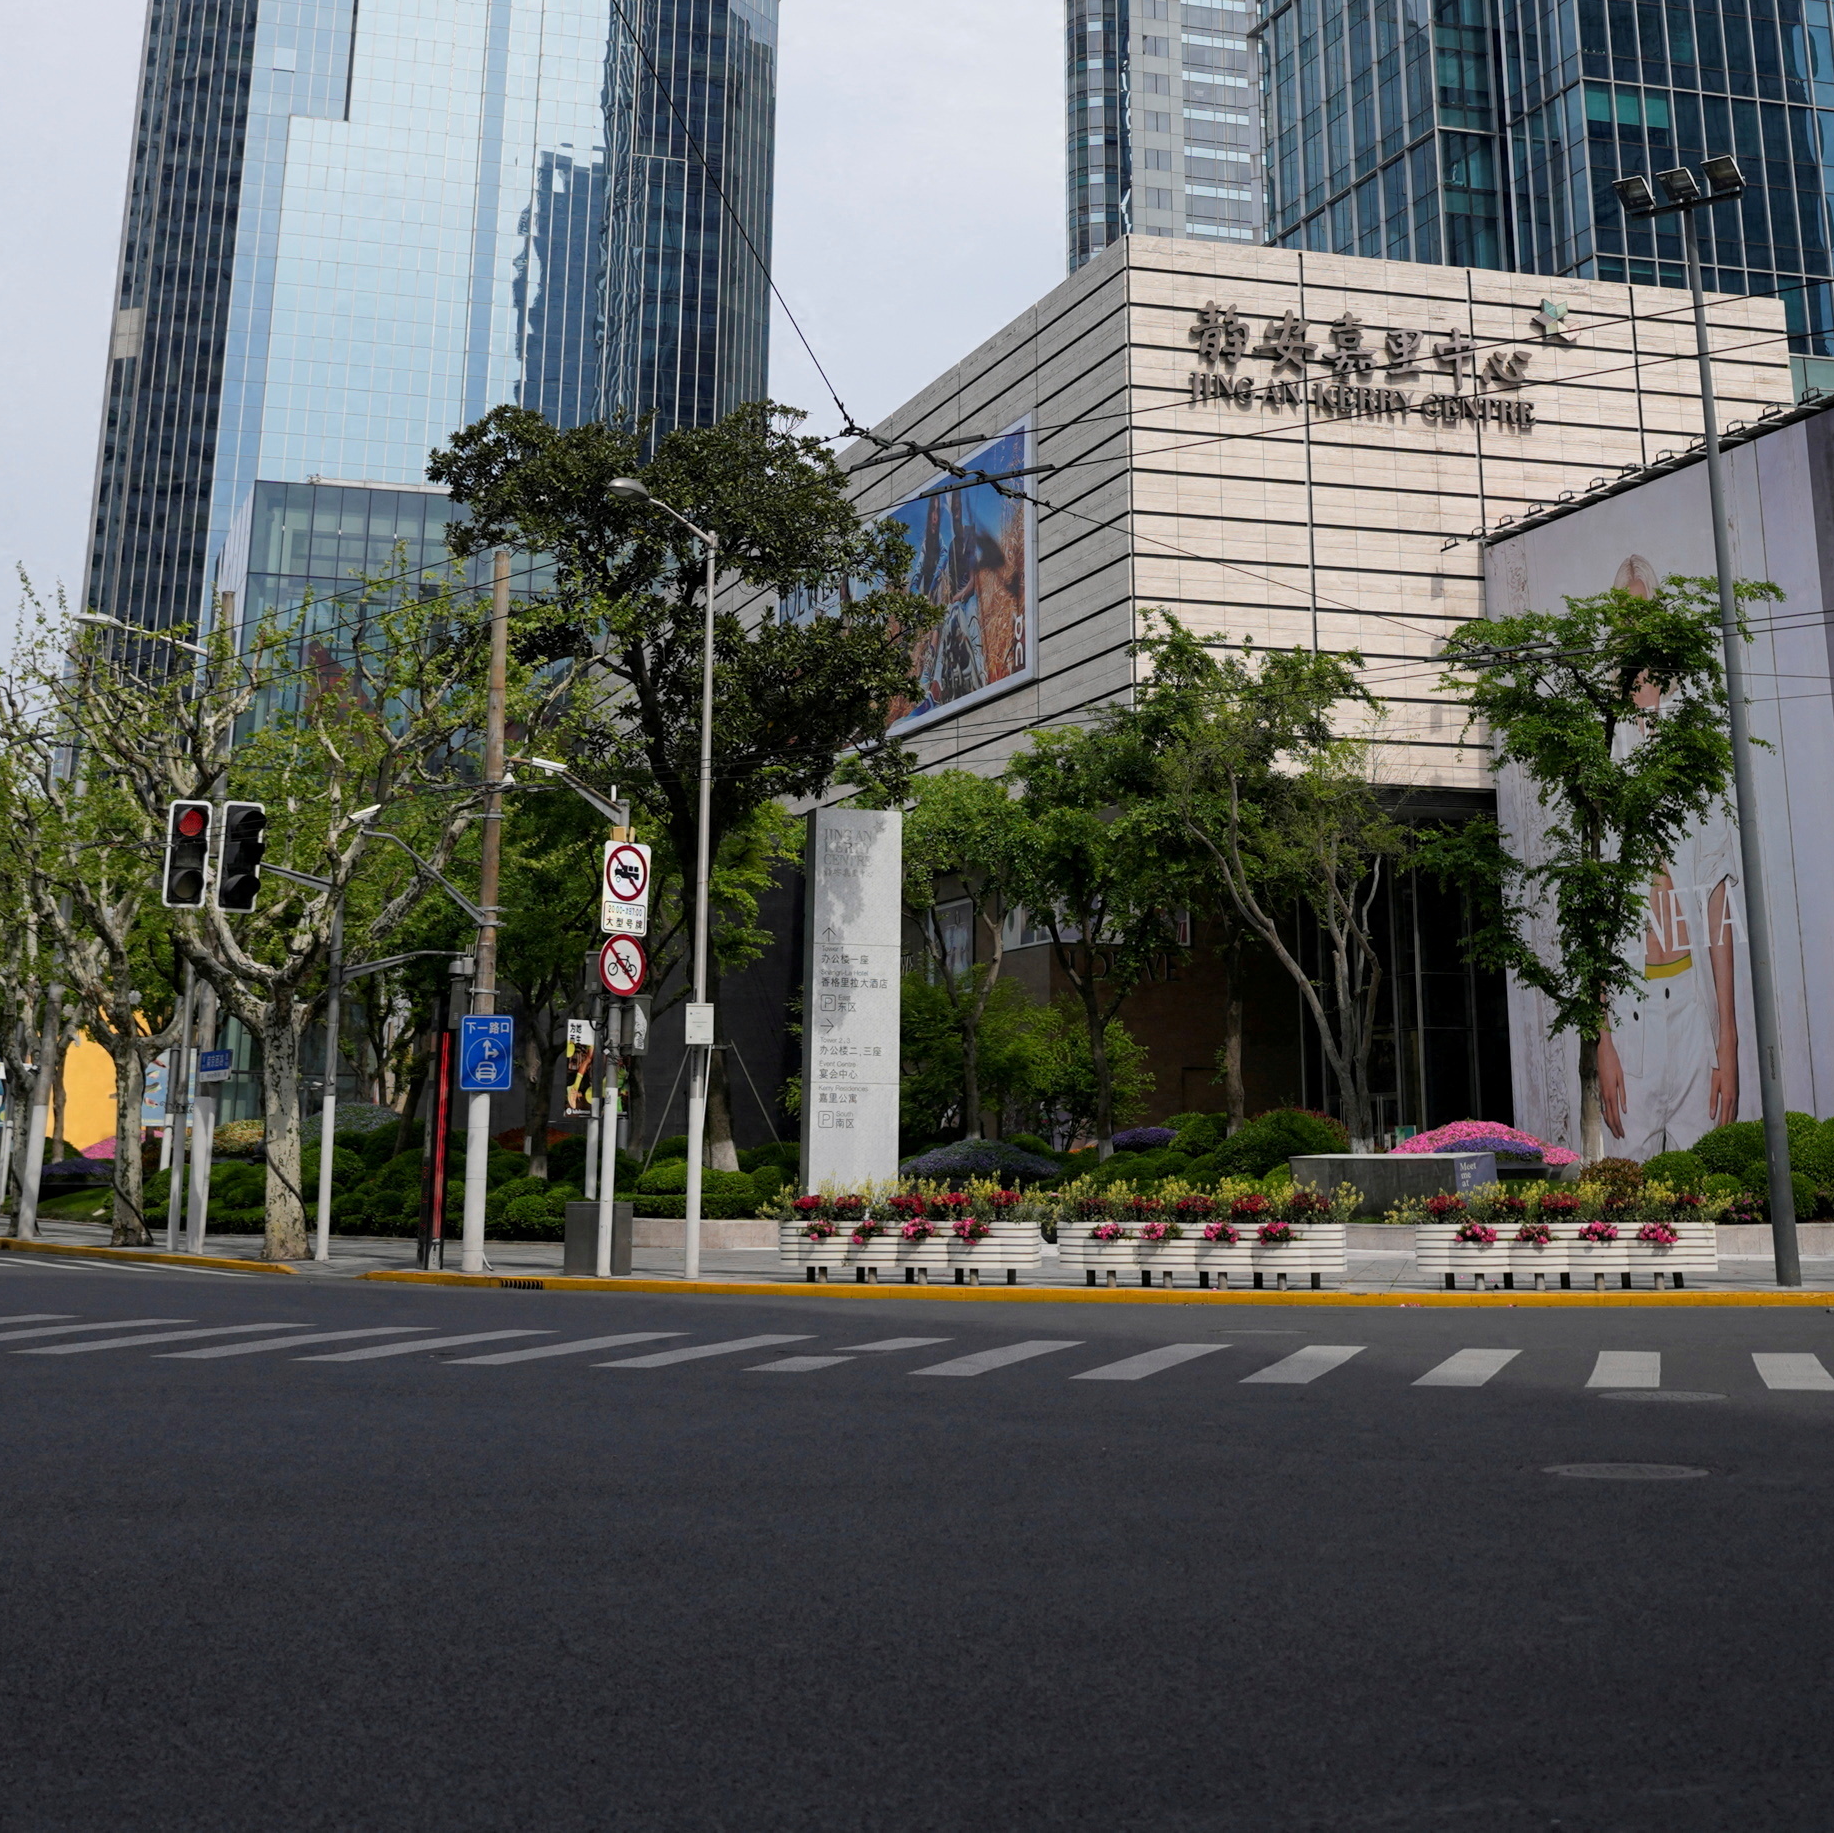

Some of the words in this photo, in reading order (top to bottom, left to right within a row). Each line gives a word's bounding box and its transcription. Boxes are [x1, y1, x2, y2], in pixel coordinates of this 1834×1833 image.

[1189, 300, 1534, 392] 静安嘉里中心
[1188, 371, 1255, 403] JING
[1261, 377, 1301, 406] AN
[1314, 383, 1415, 415] KERRY
[1422, 393, 1537, 427] CENTRE
[821, 977, 888, 989] 香格里拉大酒店
[465, 1021, 510, 1034] 下一路口
[819, 1068, 858, 1079] 宴会中心
[818, 1092, 857, 1104] 嘉里公寓
[1459, 1161, 1477, 1171] Meet
